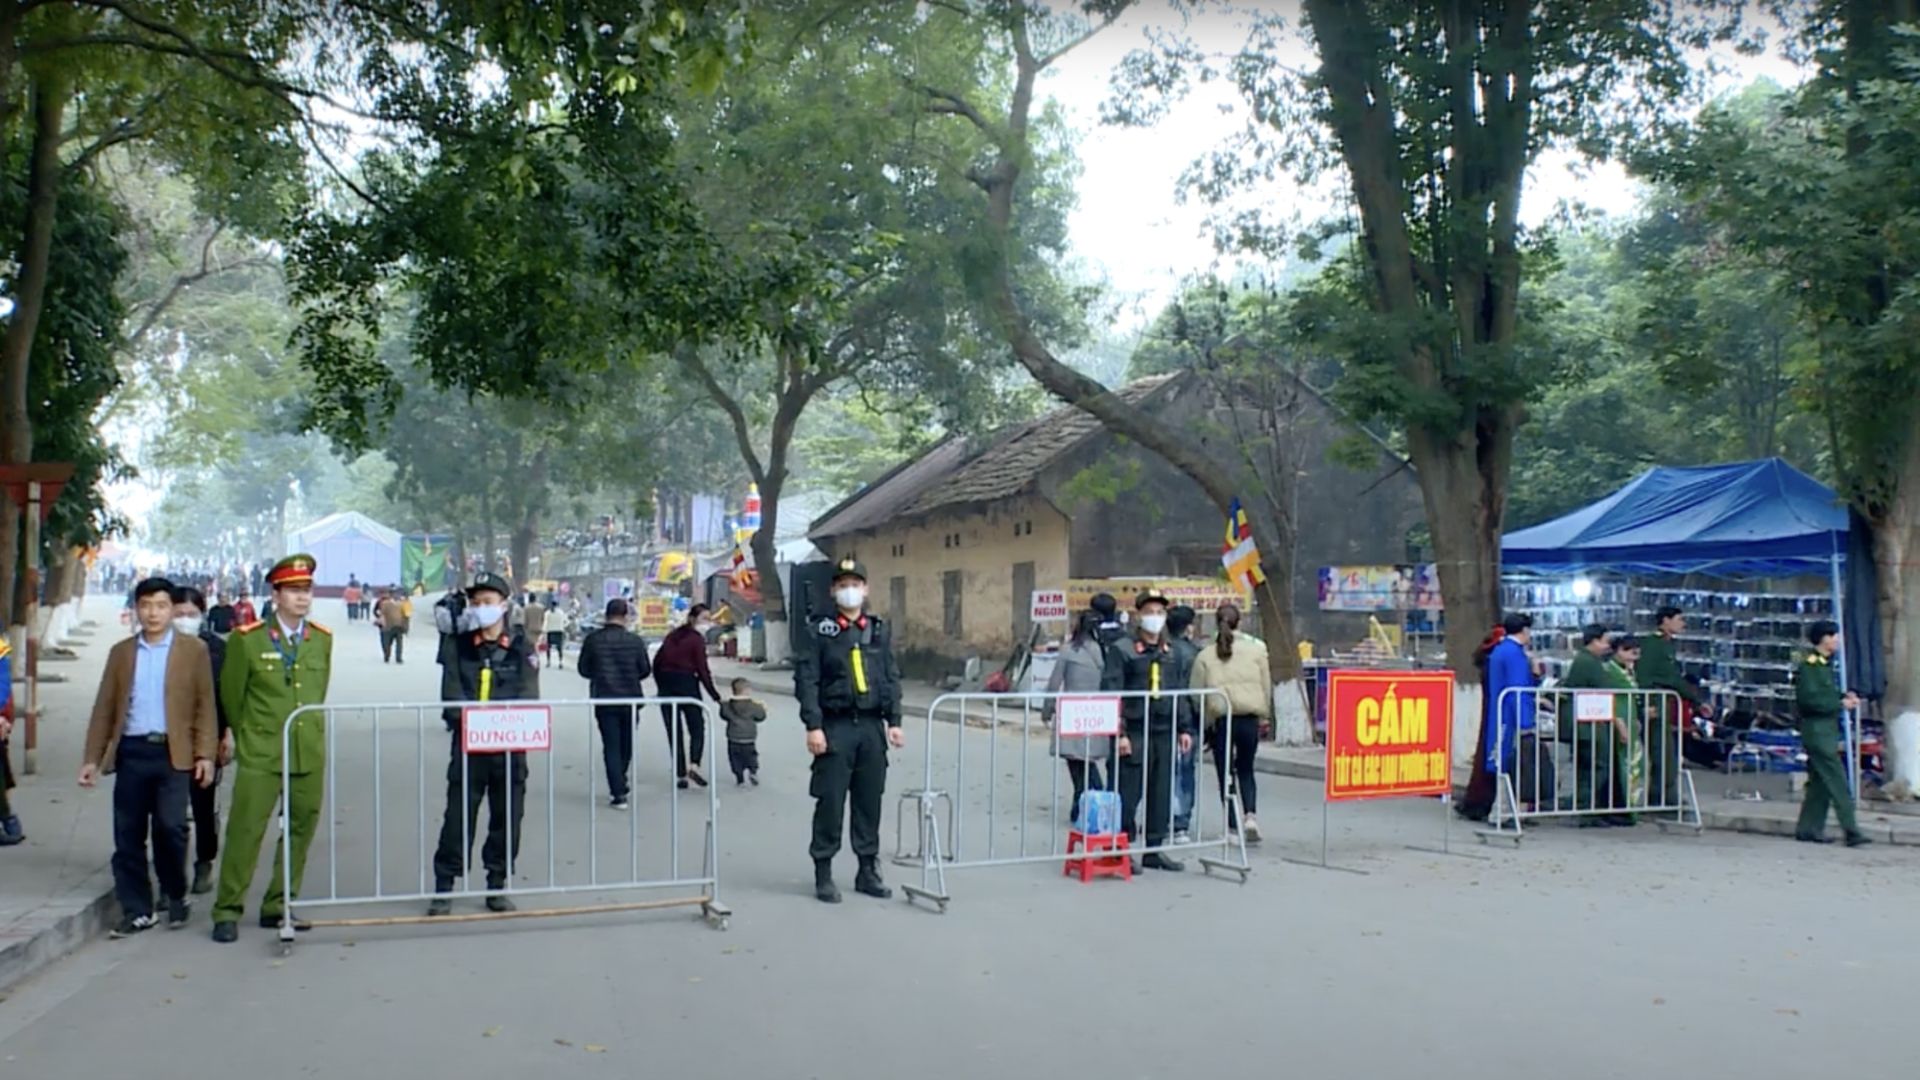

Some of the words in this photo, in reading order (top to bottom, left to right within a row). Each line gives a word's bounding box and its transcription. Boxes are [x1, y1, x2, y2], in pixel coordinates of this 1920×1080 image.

[1038, 594, 1063, 603] KEM
[1356, 682, 1429, 747] CẤM
[1073, 717, 1105, 730] STOP
